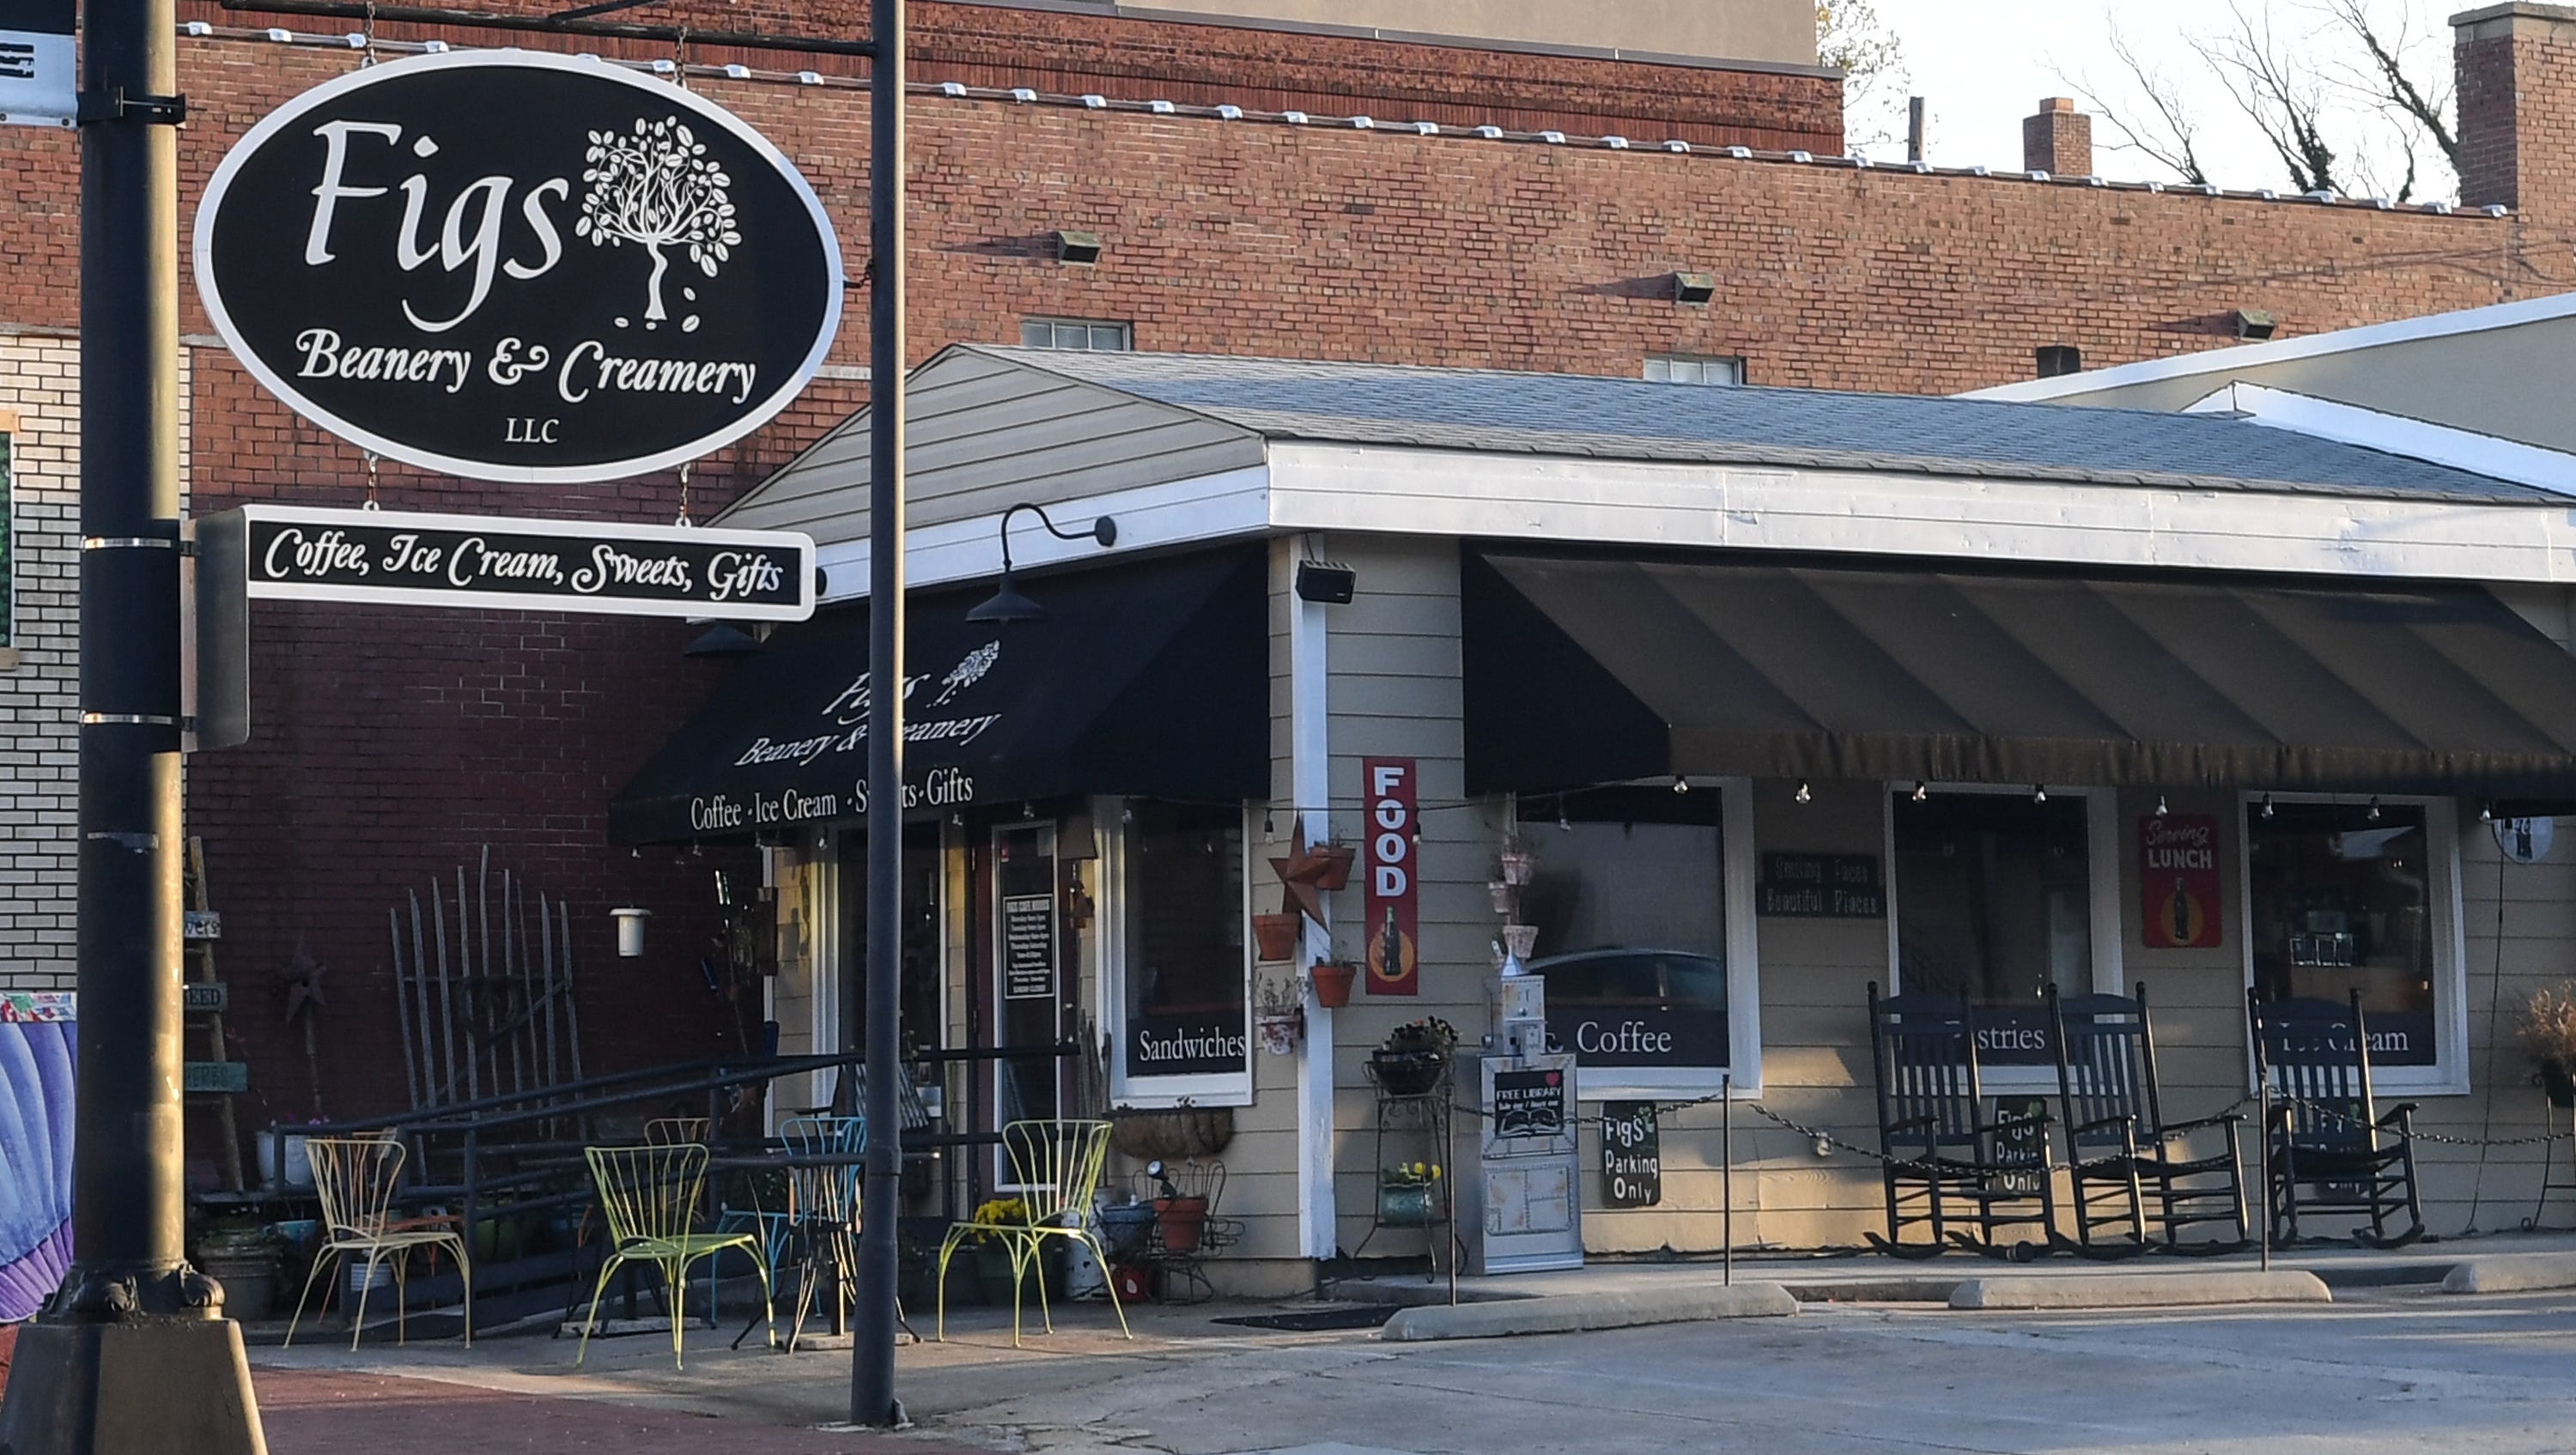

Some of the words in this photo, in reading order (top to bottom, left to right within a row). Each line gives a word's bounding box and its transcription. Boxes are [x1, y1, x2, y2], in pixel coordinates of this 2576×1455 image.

[305, 119, 569, 332] Figs
[295, 328, 471, 393] Beanery
[488, 337, 550, 386] &
[558, 340, 756, 404] Creamery
[504, 418, 560, 444] LLC
[264, 529, 370, 579] Coffee,
[382, 534, 440, 573] Ice
[447, 537, 565, 587] Cream,
[571, 544, 693, 594] Sweets,
[707, 552, 785, 601] Gifts
[733, 737, 840, 767] Beanery
[835, 724, 867, 752] &
[690, 793, 742, 831] Coffee
[755, 792, 779, 824] Ice
[782, 788, 837, 821] Cream
[927, 767, 975, 806] Gifts
[1374, 766, 1407, 898] FOOD
[2146, 819, 2209, 848] Serving
[1775, 857, 1821, 883] Smiling
[1834, 858, 1868, 883] Faces
[2148, 849, 2213, 869] LUNCH
[1766, 888, 1823, 912] Beautiful
[1834, 889, 1877, 914] Places
[1139, 1026, 1245, 1061] Sandwiches
[1577, 1022, 1673, 1053] Coffee
[1496, 1088, 1522, 1101] FREE
[1522, 1086, 1561, 1099] LIBRARY
[1605, 1149, 1658, 1179] Parking
[1613, 1177, 1652, 1204] Only
